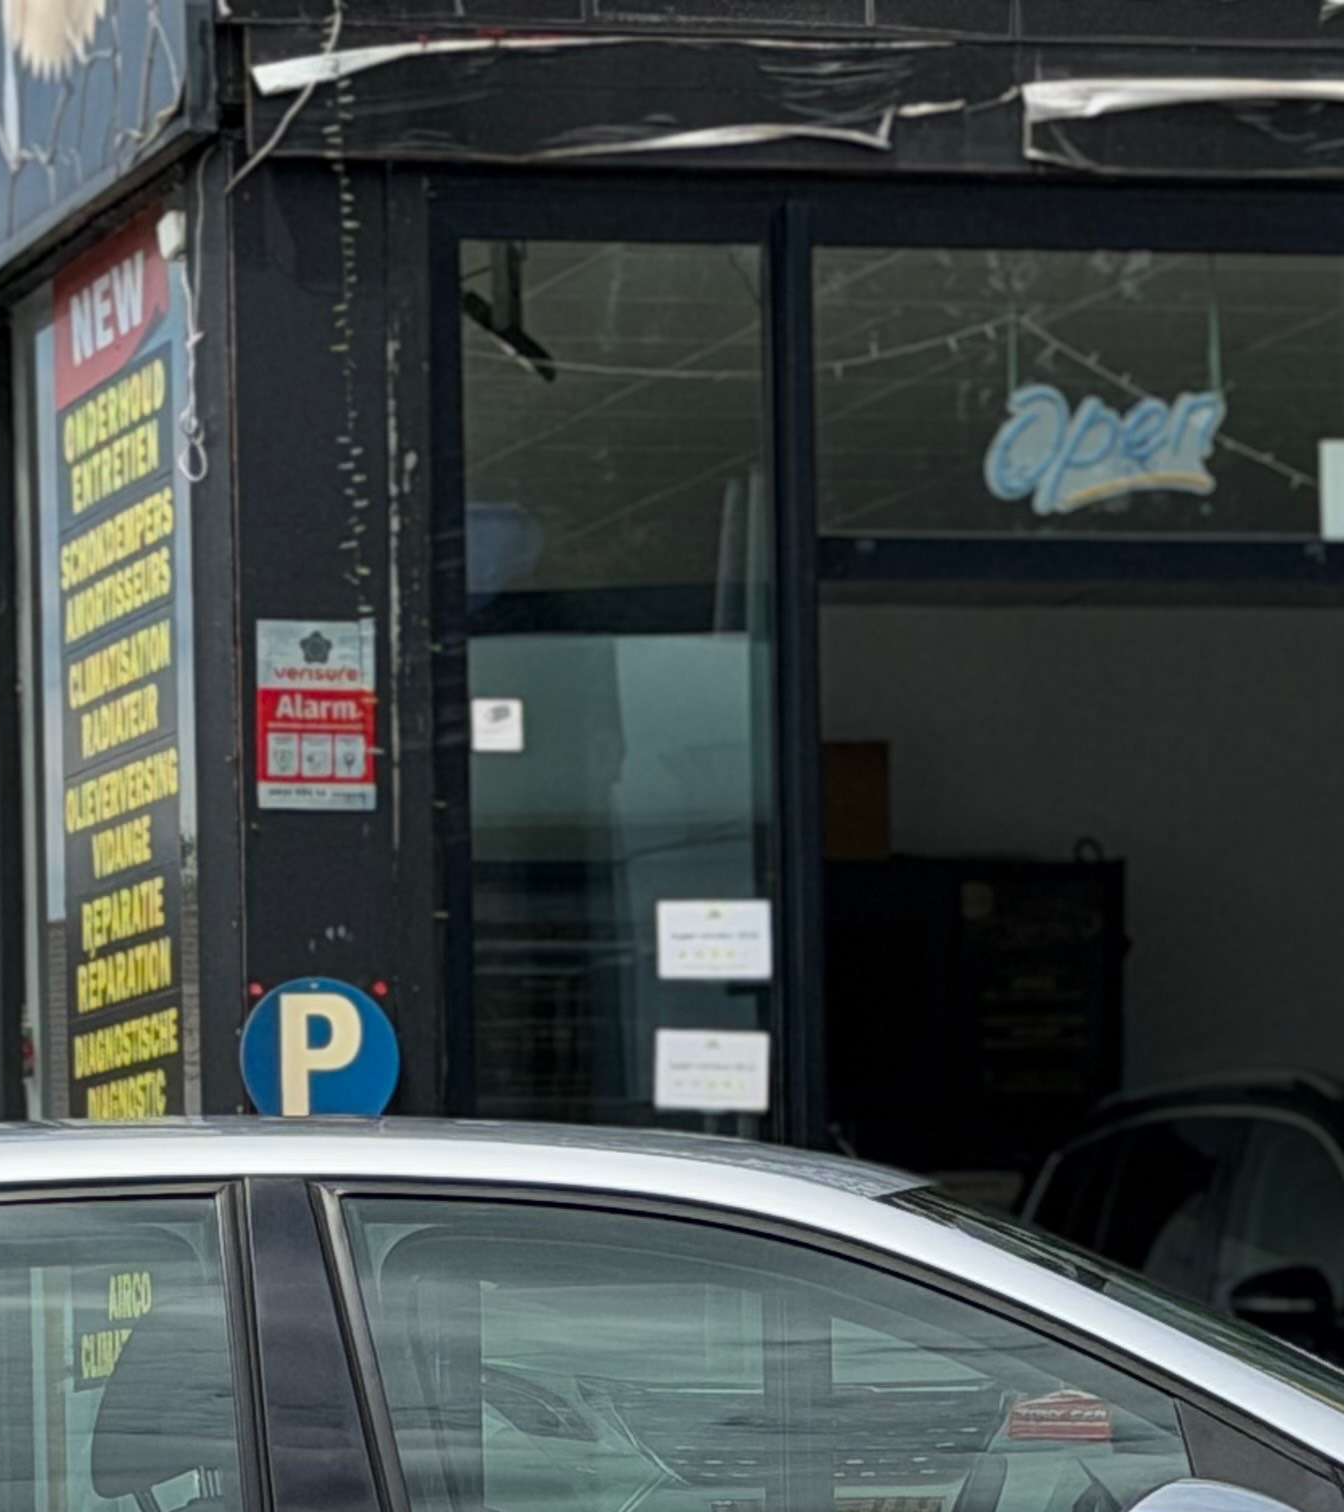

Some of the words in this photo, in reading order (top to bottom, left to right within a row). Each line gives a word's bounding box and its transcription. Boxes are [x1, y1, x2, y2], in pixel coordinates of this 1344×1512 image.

[70, 248, 145, 368] NEW
[63, 358, 166, 464] ONDERHOUD
[983, 383, 1227, 515] Open
[71, 417, 160, 515] ENTRETIEN
[61, 485, 174, 592] SCHOKDEMPERS
[65, 545, 172, 645] AMORTISSEURS
[69, 618, 171, 710] CLIMATISATION
[81, 682, 159, 760] RADIATEUR
[65, 746, 179, 835] OLIEVERVERSING
[91, 814, 152, 880] VIDANGE
[82, 875, 166, 952] REPARATIE
[74, 1006, 179, 1080] DIAGNOSTISCHE
[280, 993, 362, 1117] P
[109, 1271, 153, 1322] AIRCO
